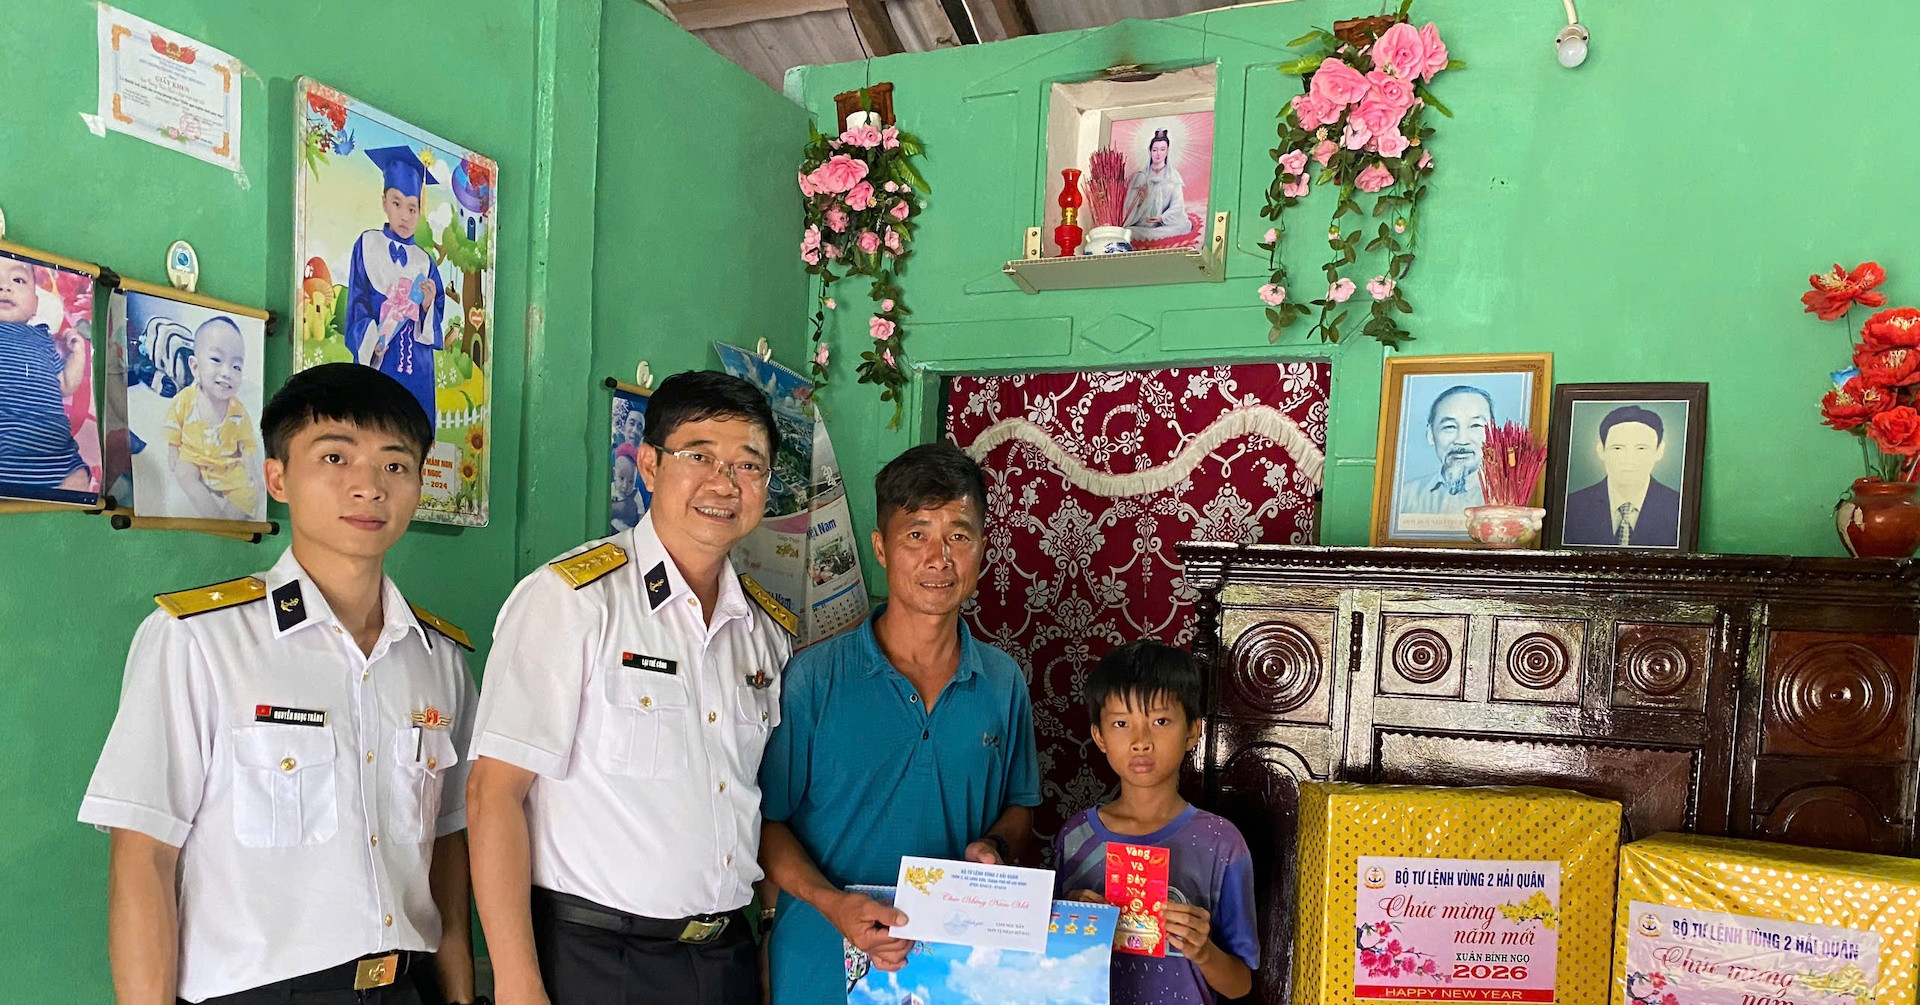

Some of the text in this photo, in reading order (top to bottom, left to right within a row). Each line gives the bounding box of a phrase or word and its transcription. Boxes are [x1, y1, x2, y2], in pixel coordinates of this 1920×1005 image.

[431, 481, 448, 489] 2024
[817, 519, 837, 534] Nam
[274, 709, 293, 720] NGUYỄN
[294, 712, 307, 722] NGỌC
[1126, 846, 1150, 860] Vàng
[1395, 868, 1545, 888] BỘ TƯ LỆNH VÙNG 2 HẢI QUÂN
[942, 892, 960, 900] Chúc
[1379, 895, 1497, 929] Chúc mừng
[1454, 926, 1536, 945] năm mới
[1672, 918, 1859, 960] BỘ TƯ LỆNH VÙNG 2 HẢI QUÂN
[1456, 953, 1530, 965] XUÂN BÍNH NGỌ
[1453, 964, 1528, 980] 2026
[1385, 988, 1522, 999] HAPPY NEW YEAR
